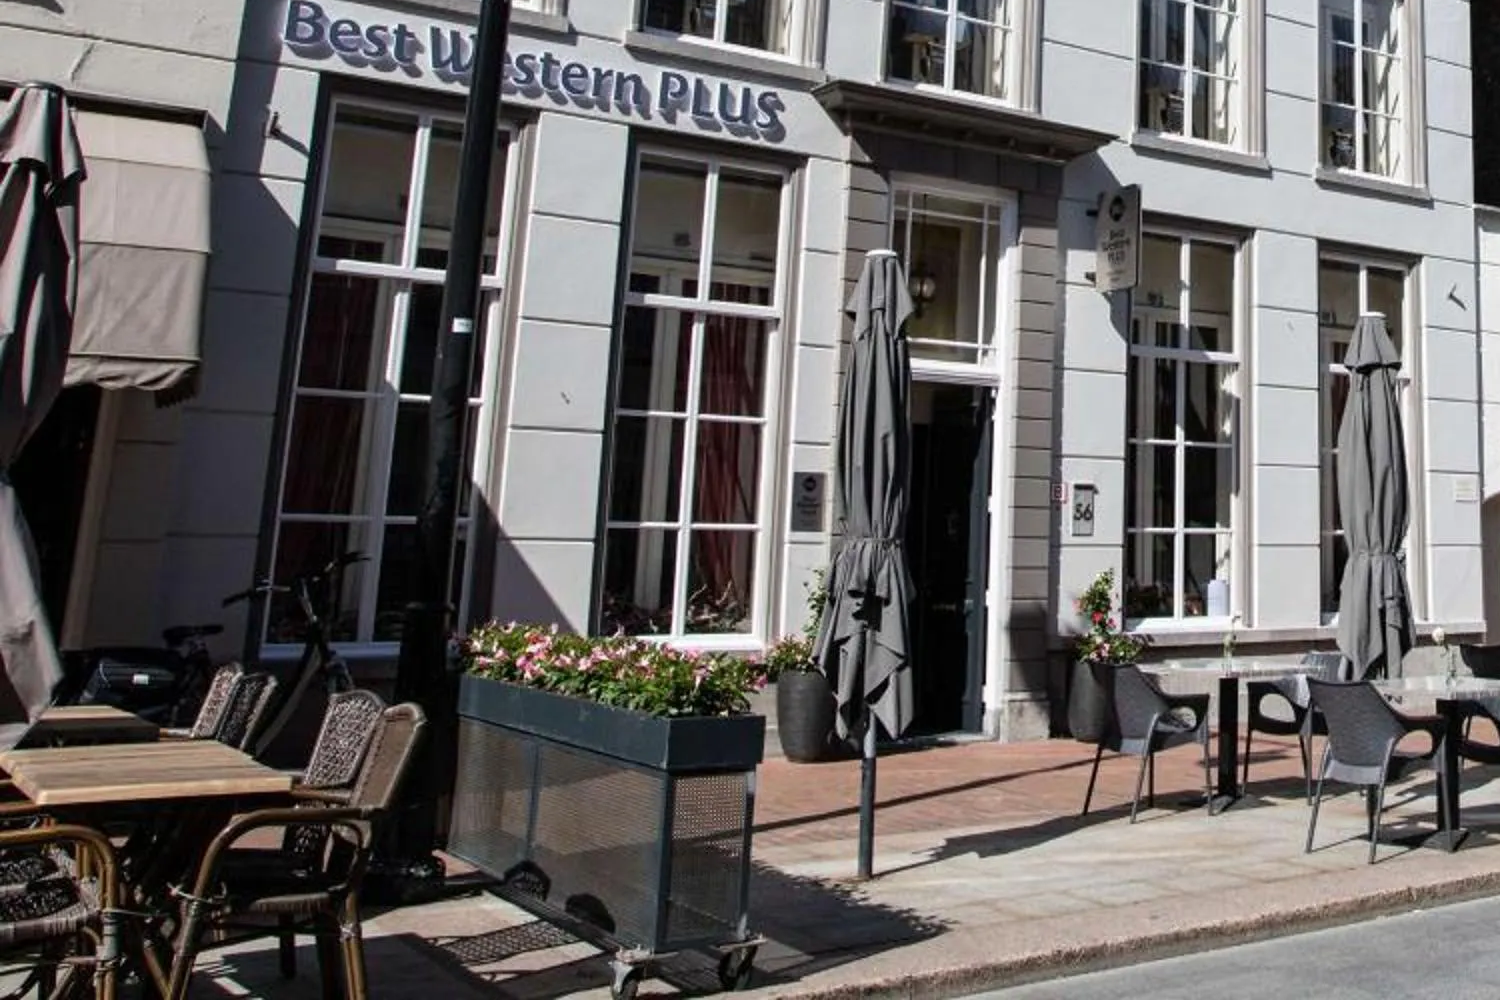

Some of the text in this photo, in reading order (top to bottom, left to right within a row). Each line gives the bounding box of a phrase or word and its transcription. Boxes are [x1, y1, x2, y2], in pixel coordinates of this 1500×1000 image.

[286, 0, 786, 128] Best Wstern PLUS
